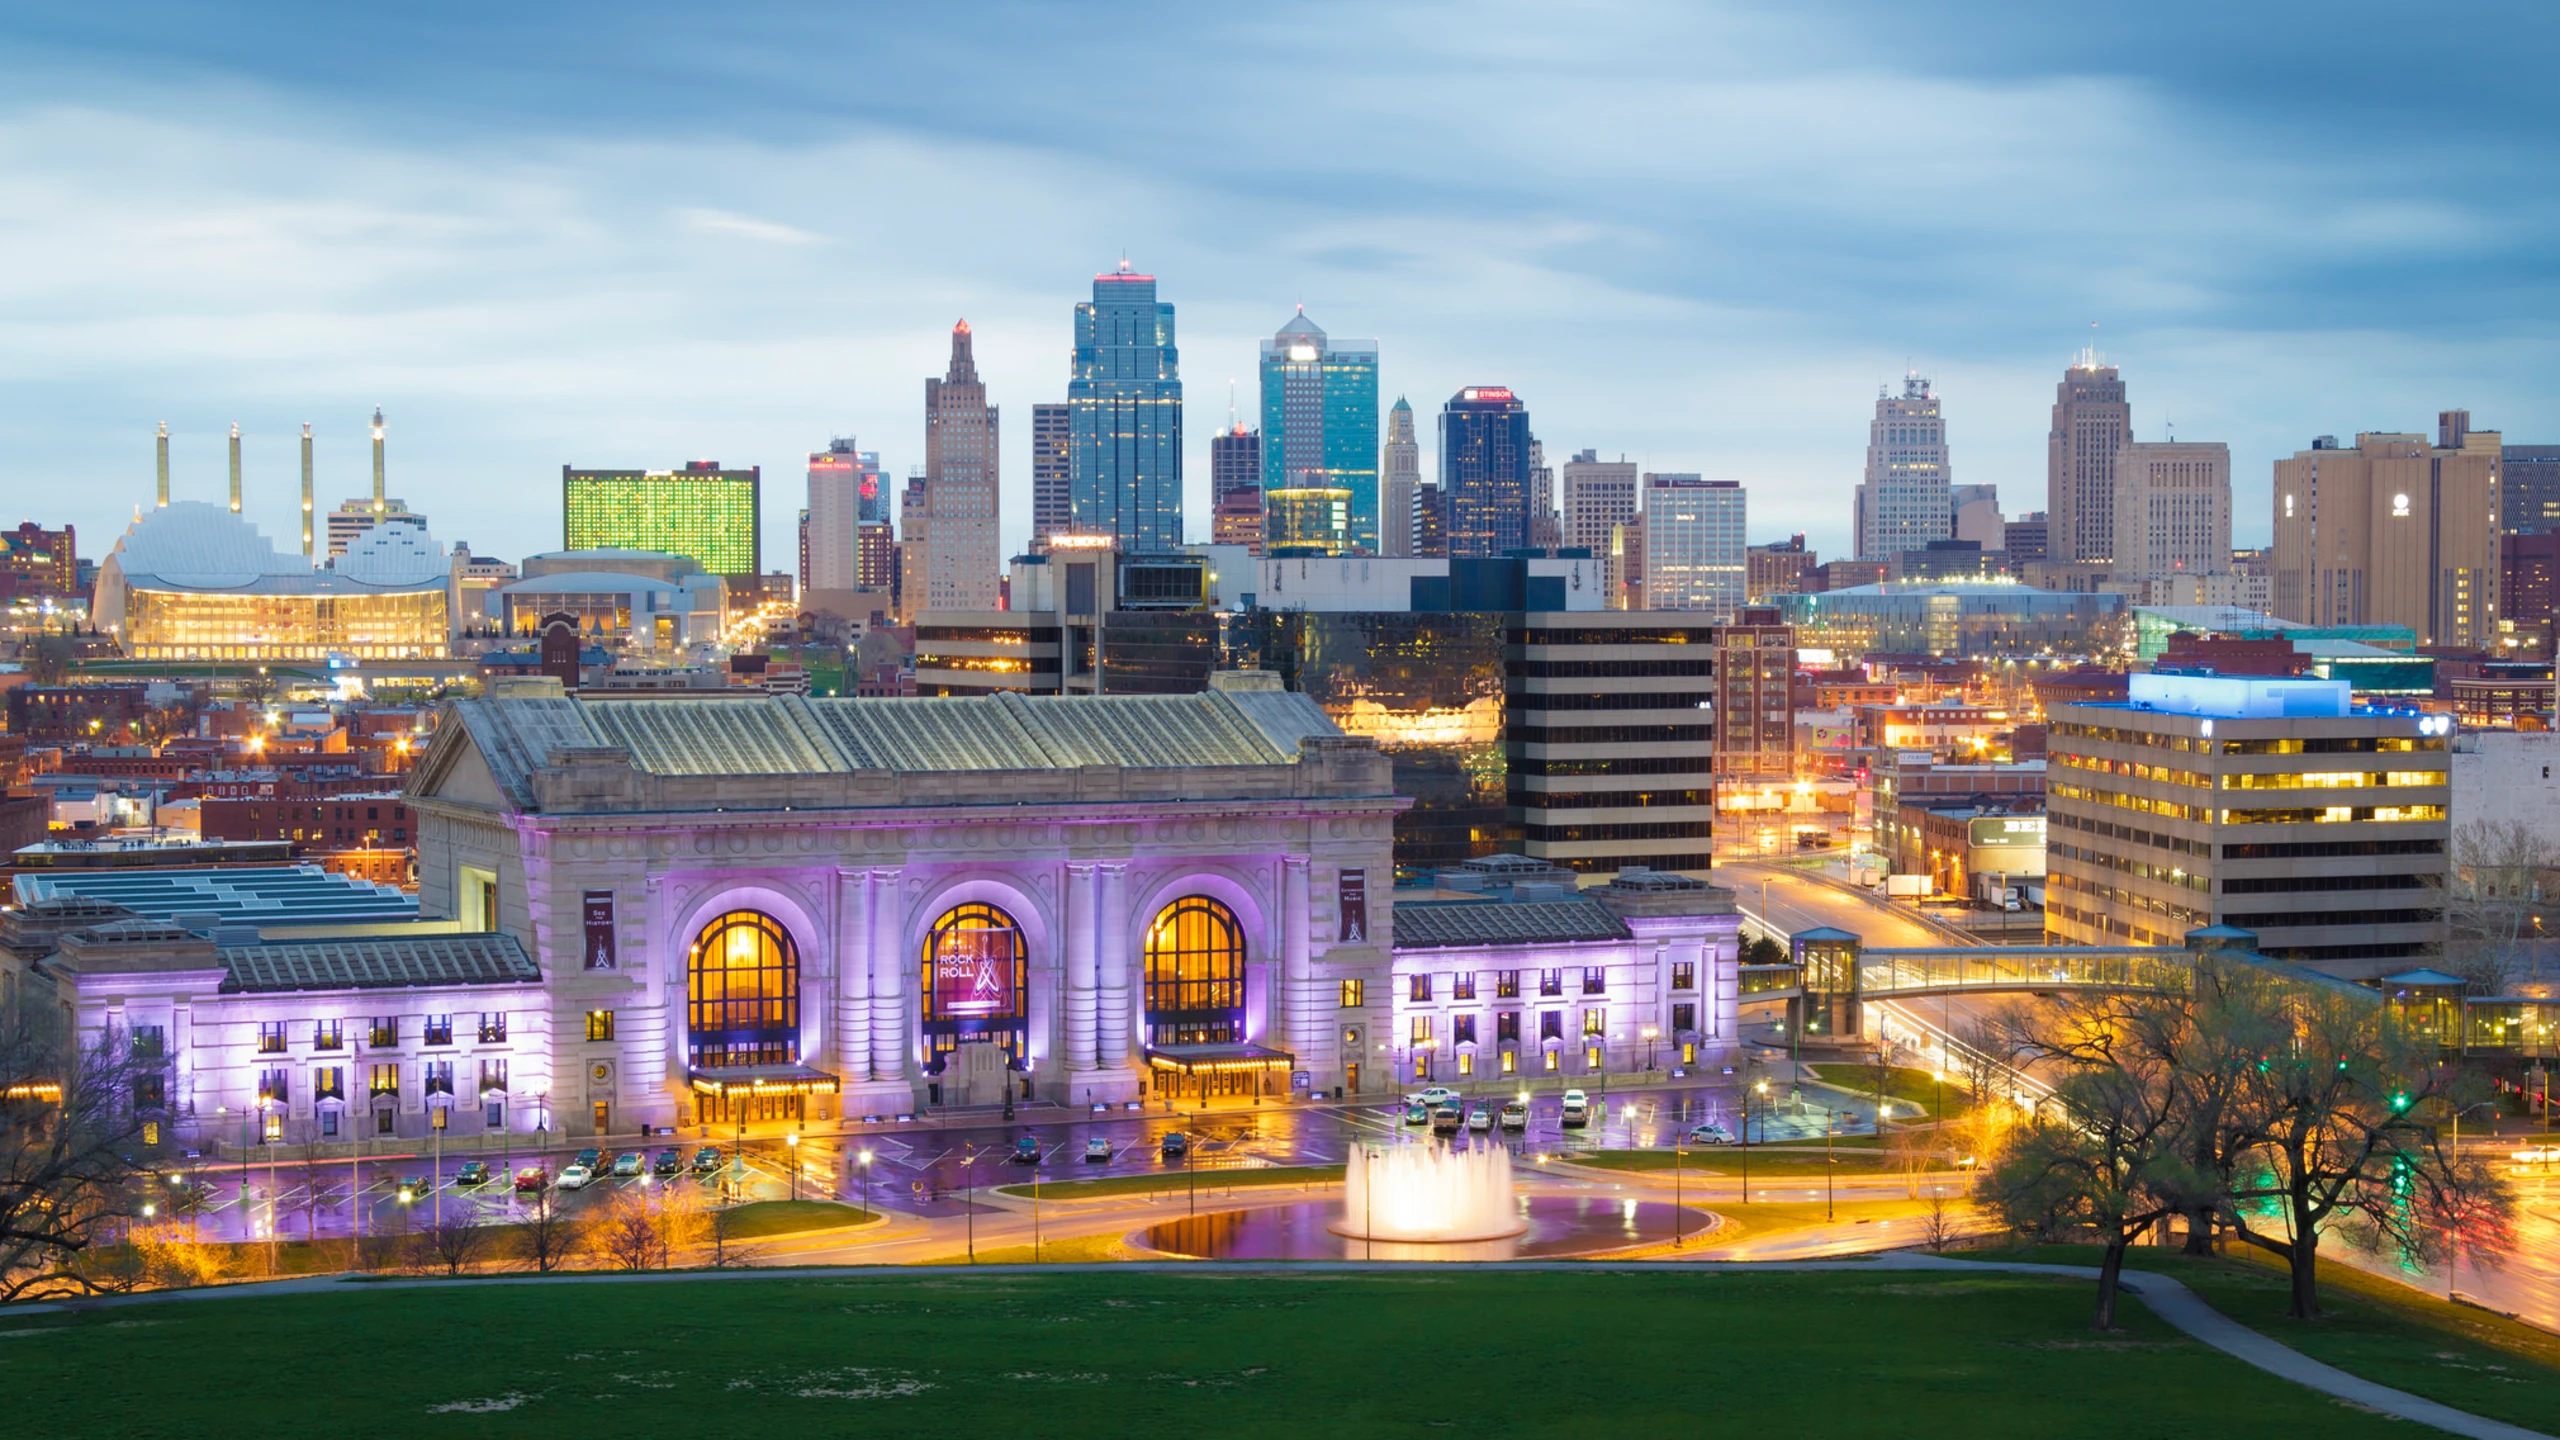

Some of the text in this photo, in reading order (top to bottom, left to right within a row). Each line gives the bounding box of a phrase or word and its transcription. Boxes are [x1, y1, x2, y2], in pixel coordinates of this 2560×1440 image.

[1479, 390, 1511, 398] STINSON
[1051, 536, 1112, 547] PRESIDENT
[940, 954, 974, 965] ROCK
[940, 966, 974, 978] ROLL
